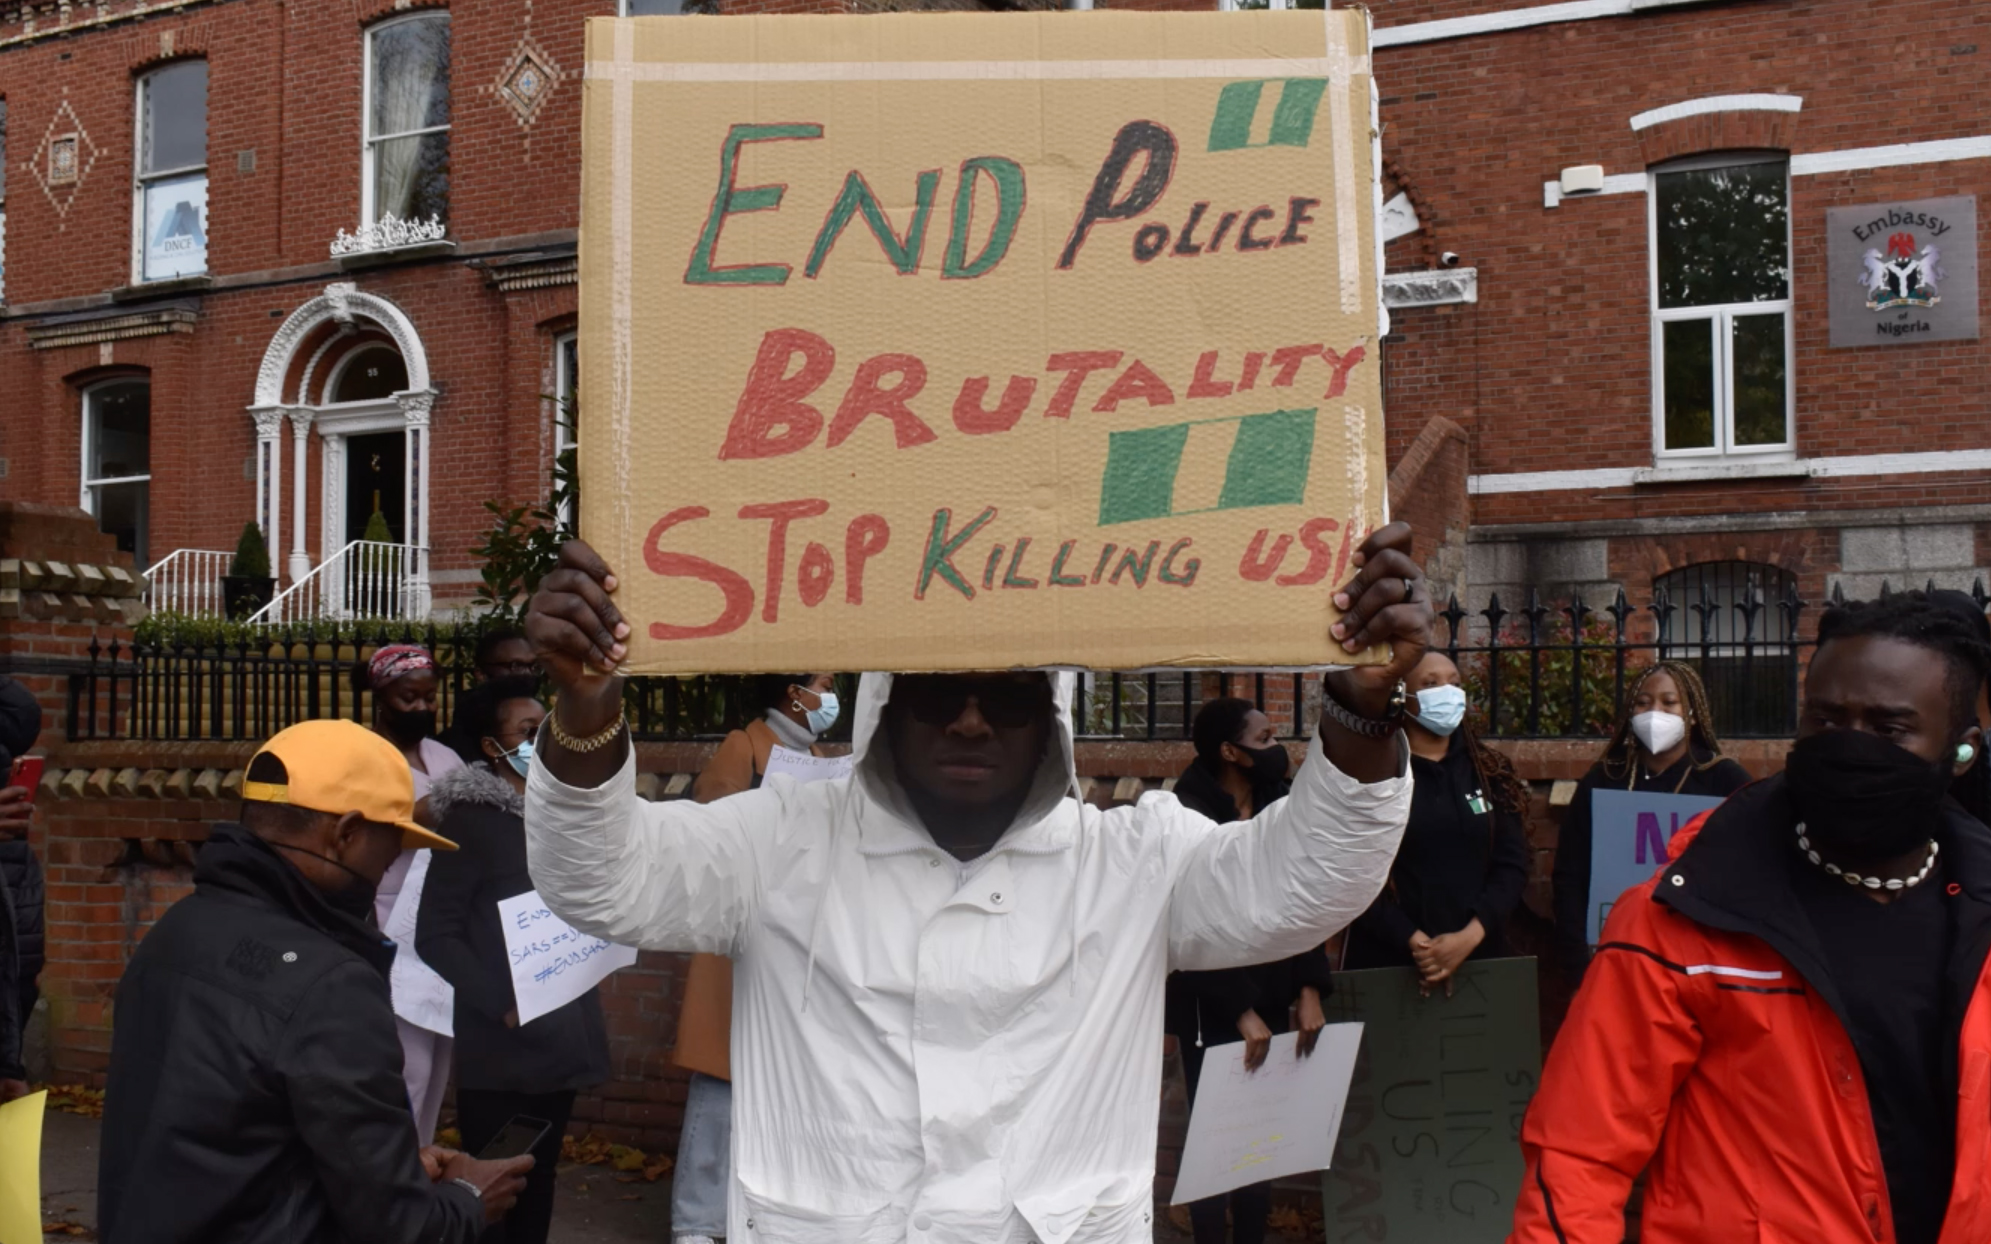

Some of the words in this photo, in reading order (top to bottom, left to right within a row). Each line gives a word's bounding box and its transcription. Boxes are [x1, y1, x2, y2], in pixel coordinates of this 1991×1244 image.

[683, 122, 1027, 287] END
[1053, 118, 1321, 270] POLICE
[1852, 209, 1951, 243] Embassy
[1876, 320, 1931, 337] Nigeria
[1898, 311, 1908, 320] of
[718, 327, 1366, 460] BRUTALITY
[643, 499, 890, 640] STOP
[914, 505, 1201, 601] KILLING
[1635, 811, 1705, 865] N
[1381, 1079, 1439, 1159] US
[1438, 969, 1500, 1221] KILLING
